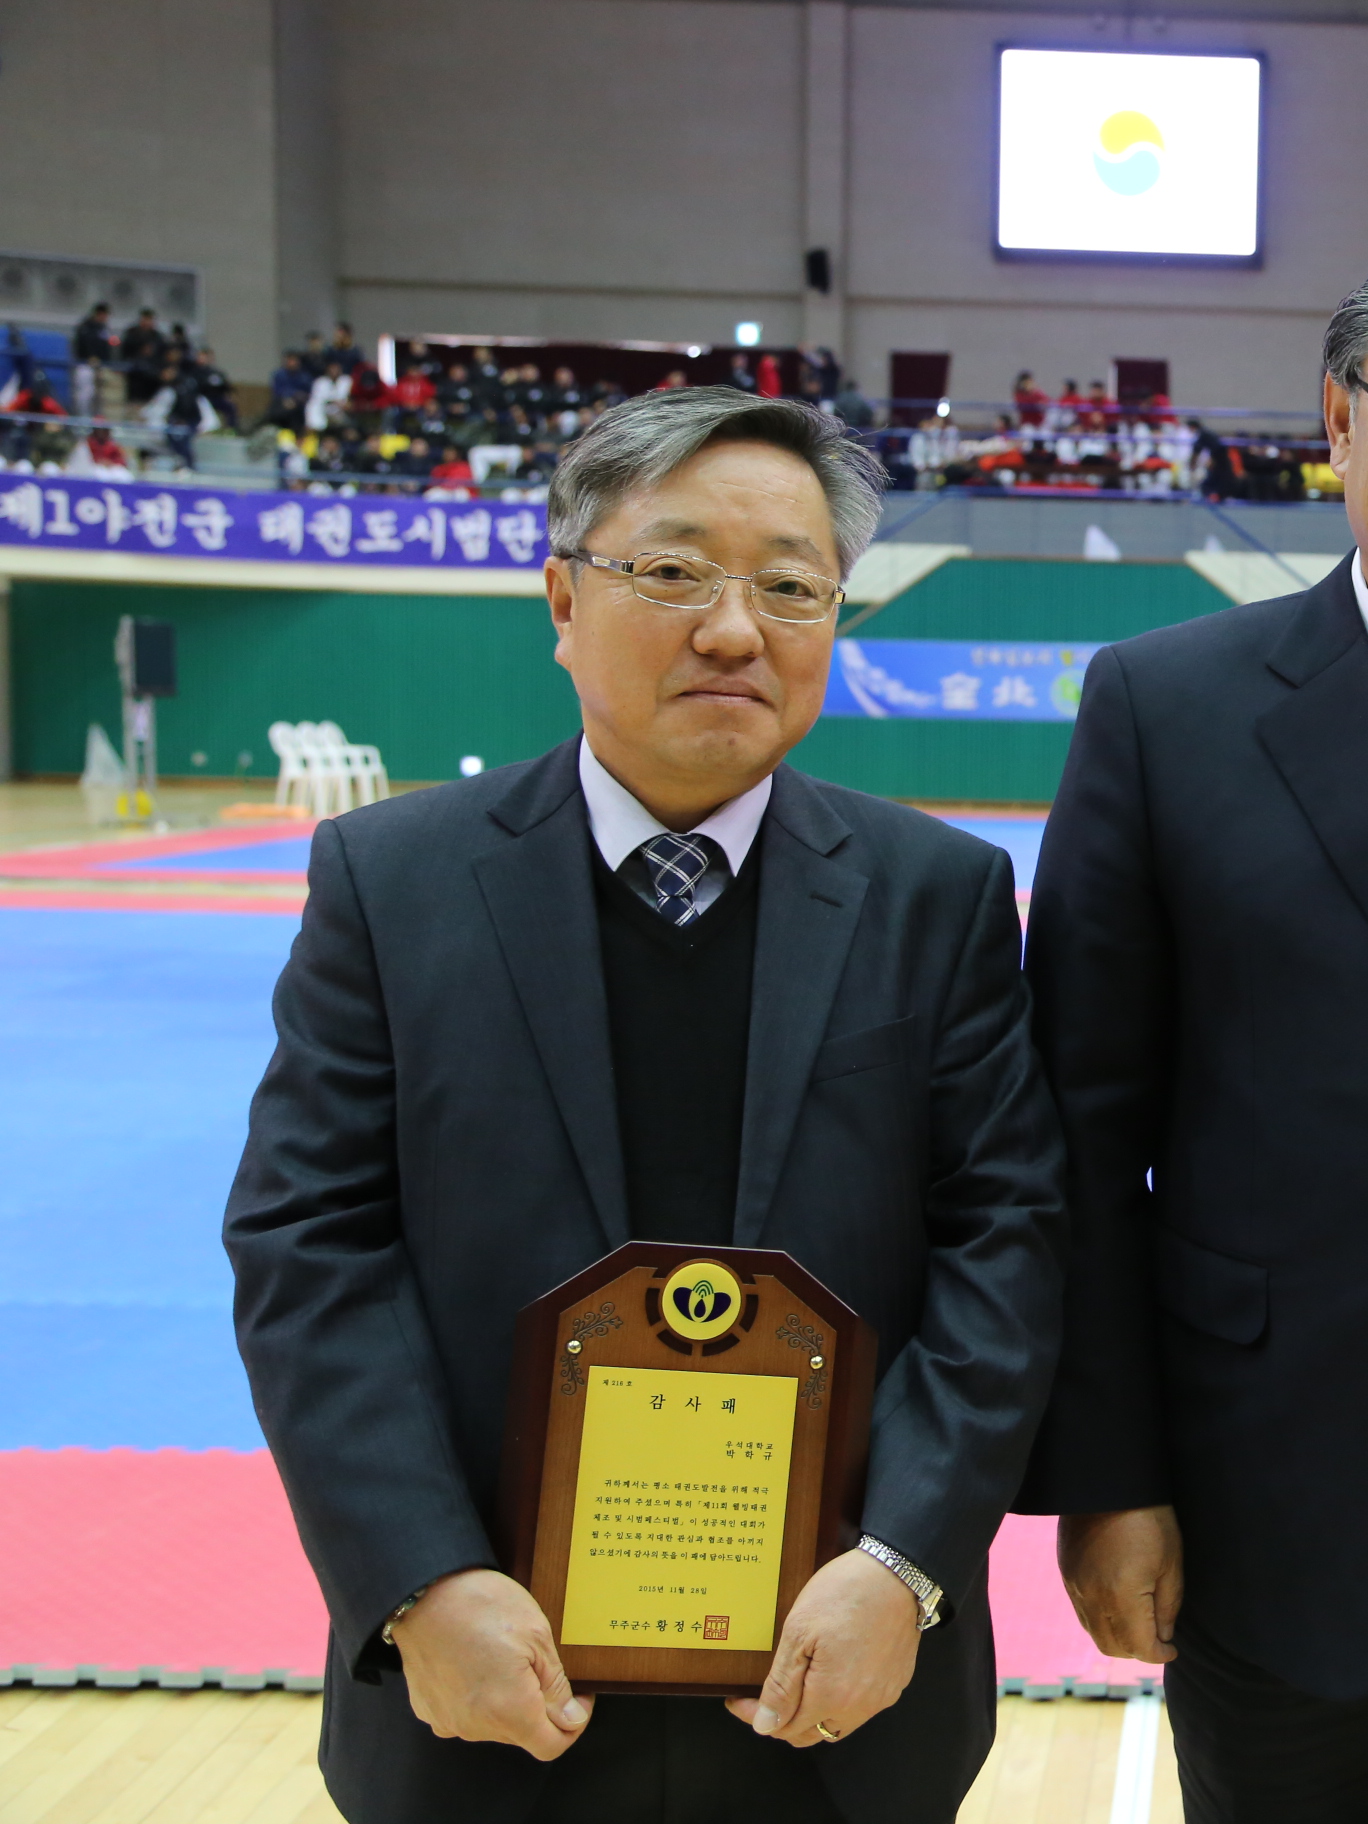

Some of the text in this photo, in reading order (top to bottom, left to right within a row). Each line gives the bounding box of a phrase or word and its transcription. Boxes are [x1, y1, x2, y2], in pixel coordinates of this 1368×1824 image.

[0, 482, 542, 562] 제1야전군 태권도시범단
[726, 1441, 773, 1450] 우석대학교
[595, 1496, 630, 1505] 지원하여
[691, 1587, 707, 1595] 28일
[610, 1620, 650, 1630] 무주군수
